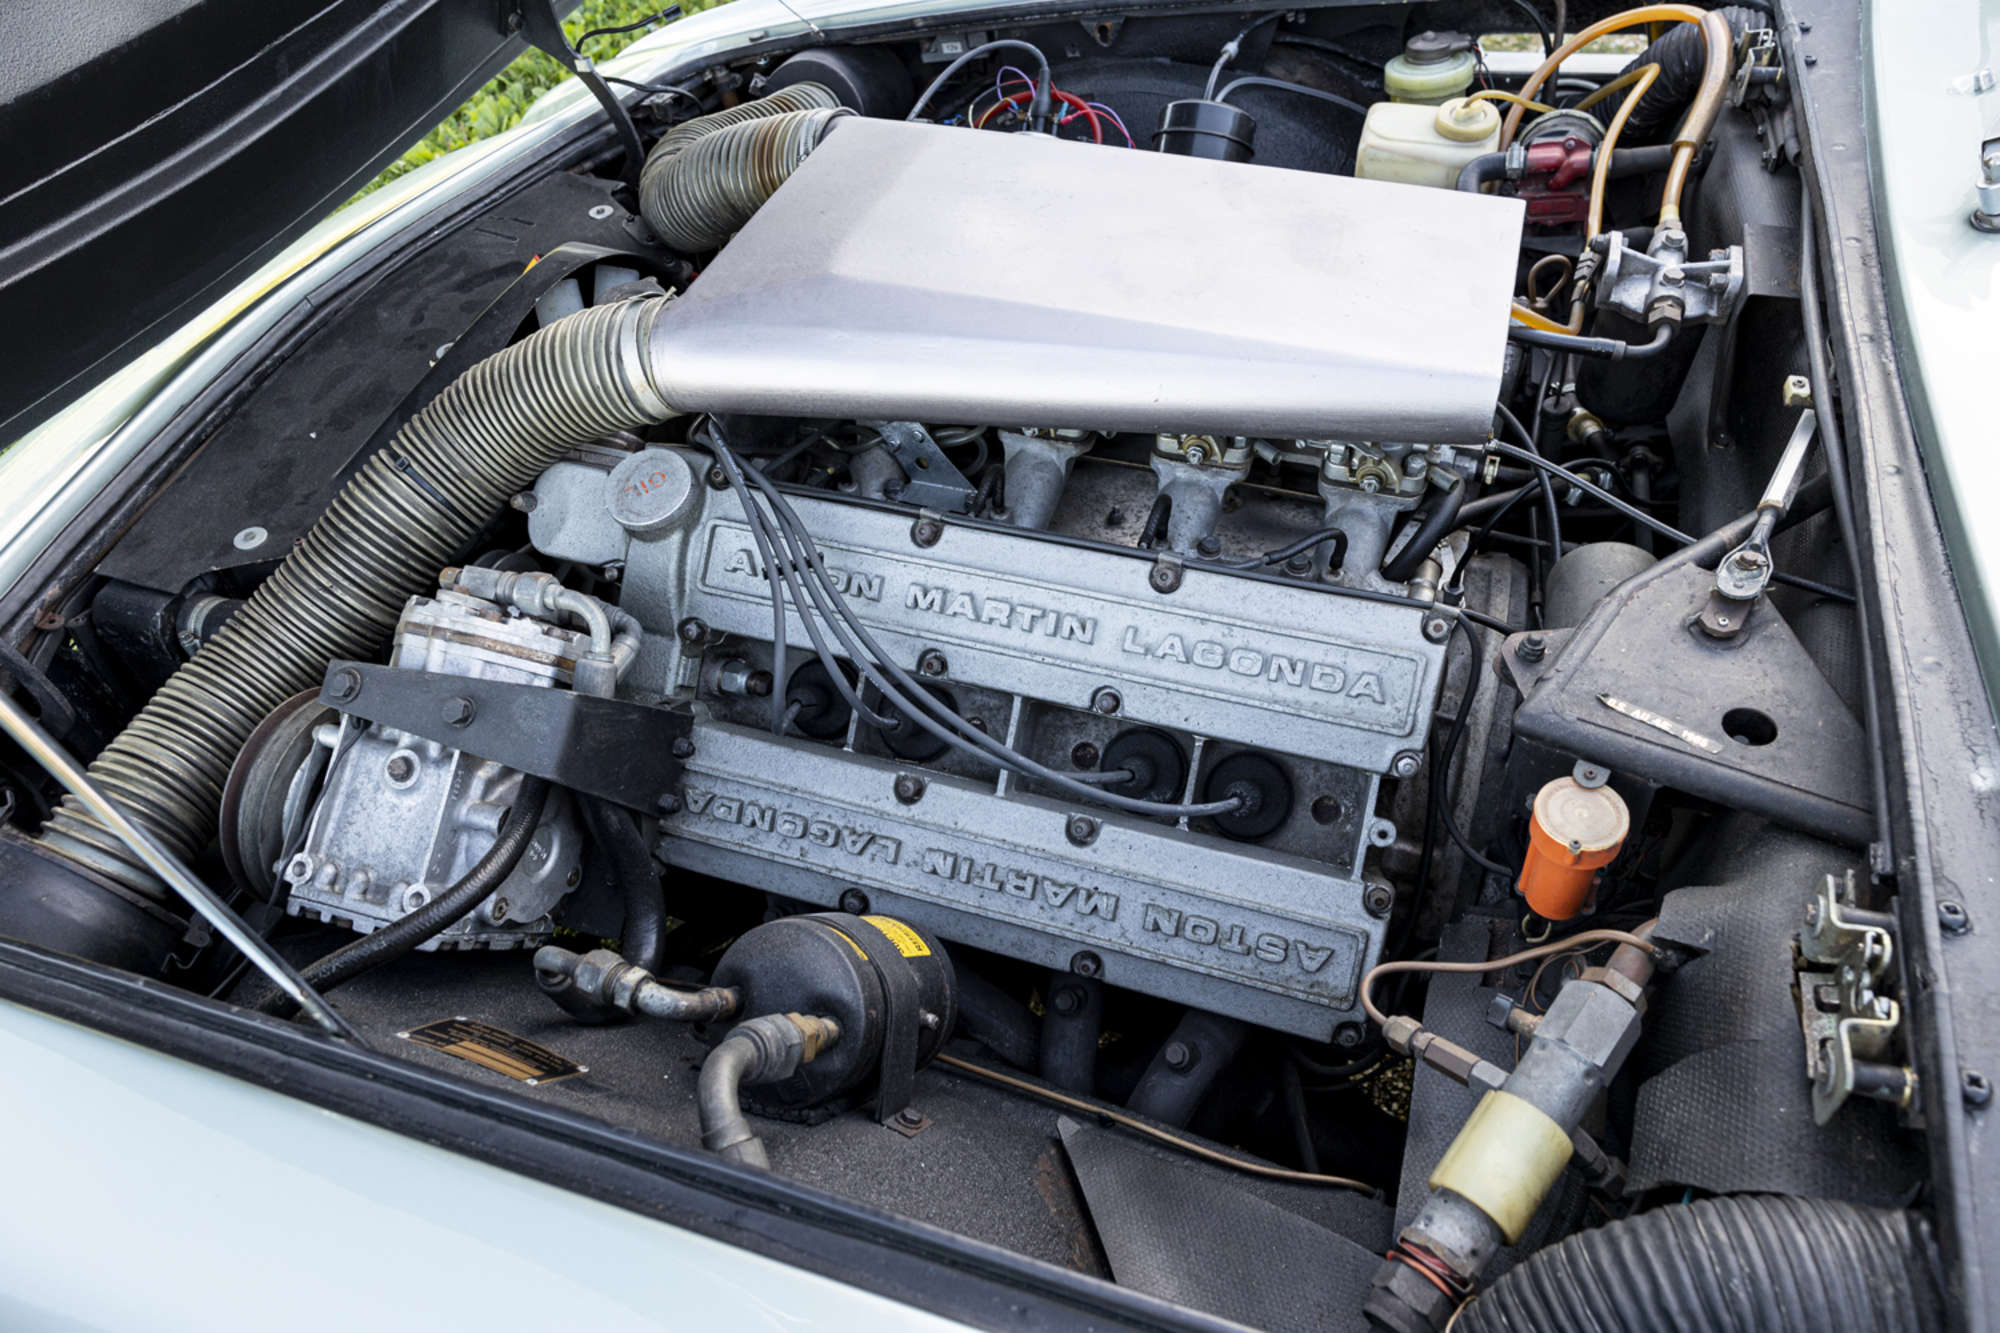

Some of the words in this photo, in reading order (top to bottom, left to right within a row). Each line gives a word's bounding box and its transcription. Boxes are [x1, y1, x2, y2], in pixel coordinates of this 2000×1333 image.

[724, 548, 885, 603] AON
[904, 582, 1098, 646] MARTIN
[1121, 625, 1386, 705] LAGONDA
[683, 784, 902, 866] LAGONDA
[922, 847, 1120, 922] MARTIN
[1142, 903, 1336, 974] ASTON
